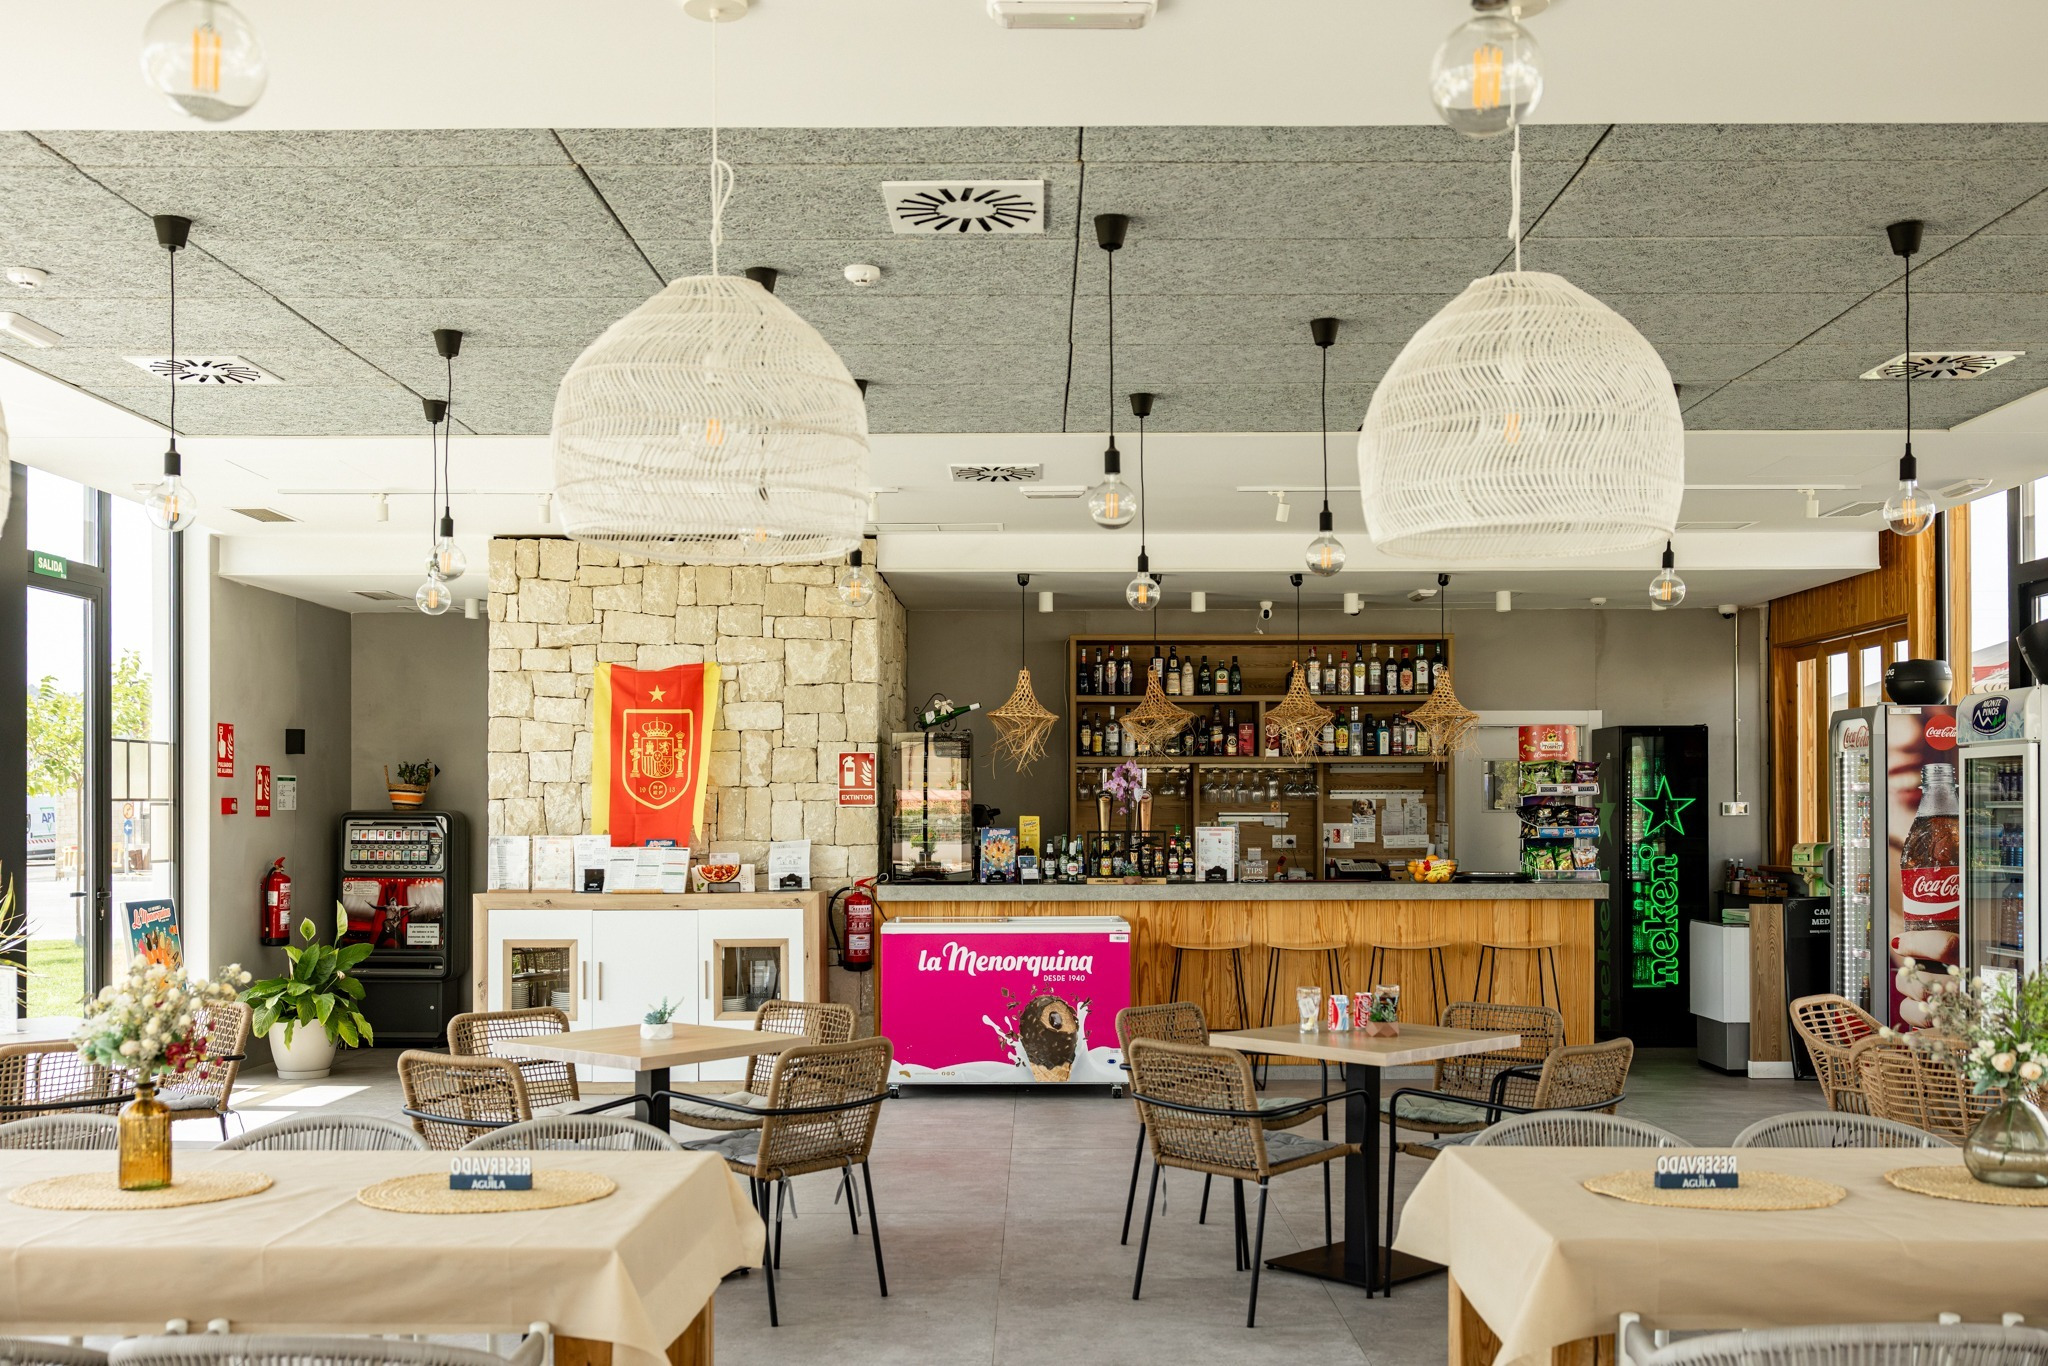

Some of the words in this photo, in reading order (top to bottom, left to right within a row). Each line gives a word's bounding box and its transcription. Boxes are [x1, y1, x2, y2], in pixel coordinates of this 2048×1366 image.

[38, 556, 63, 573] SALIDA
[1982, 699, 2002, 708] MONTE
[1982, 707, 2000, 716] PINOS
[1912, 874, 1960, 898] Coca-Co
[1643, 853, 1679, 985] neken
[918, 949, 942, 971] la
[942, 941, 1093, 977] Menorquina
[1043, 974, 1066, 982] DESDE
[1069, 974, 1085, 982] 1940
